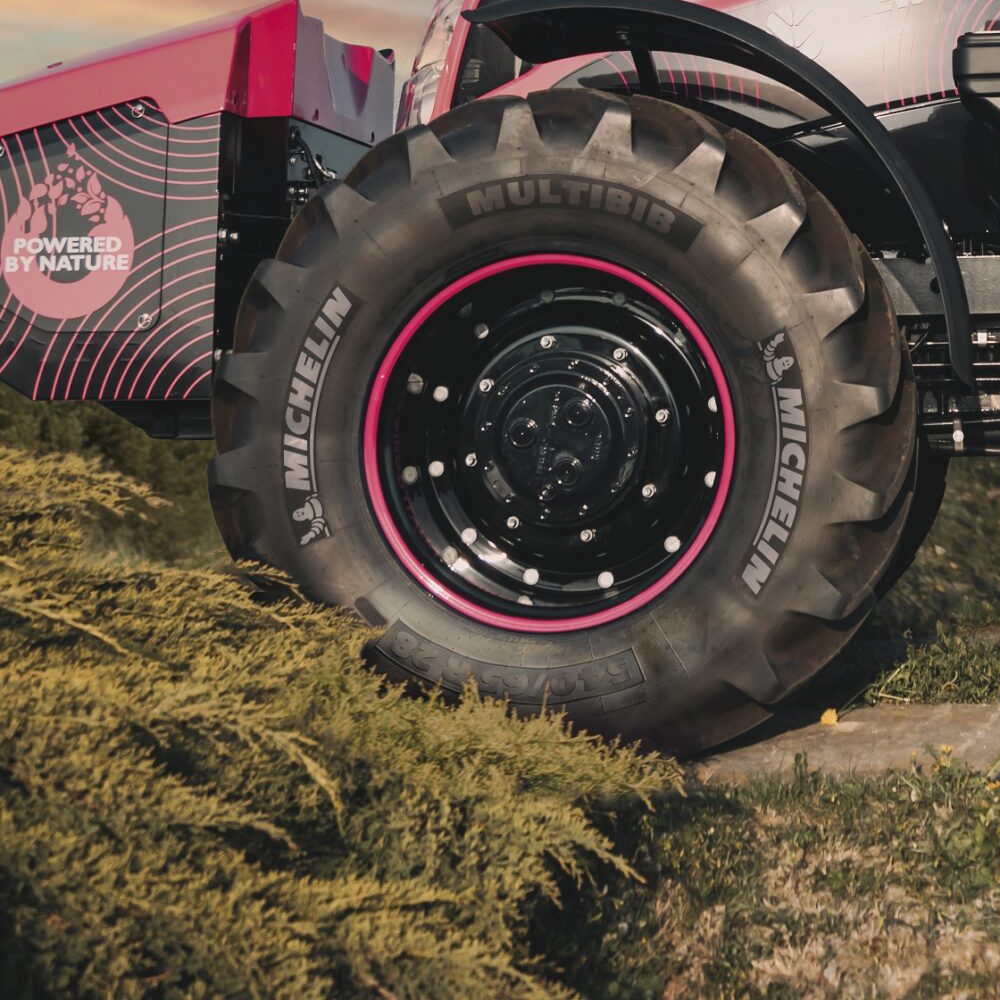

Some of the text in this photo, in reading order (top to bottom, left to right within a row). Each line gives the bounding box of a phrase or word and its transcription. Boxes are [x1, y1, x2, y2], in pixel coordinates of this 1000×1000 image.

[466, 177, 676, 235] MULTIBIB
[5, 254, 129, 273] BY NATURE
[13, 236, 122, 255] POWERED
[284, 286, 354, 489] MICHELIN
[740, 386, 810, 597] MICHELIN
